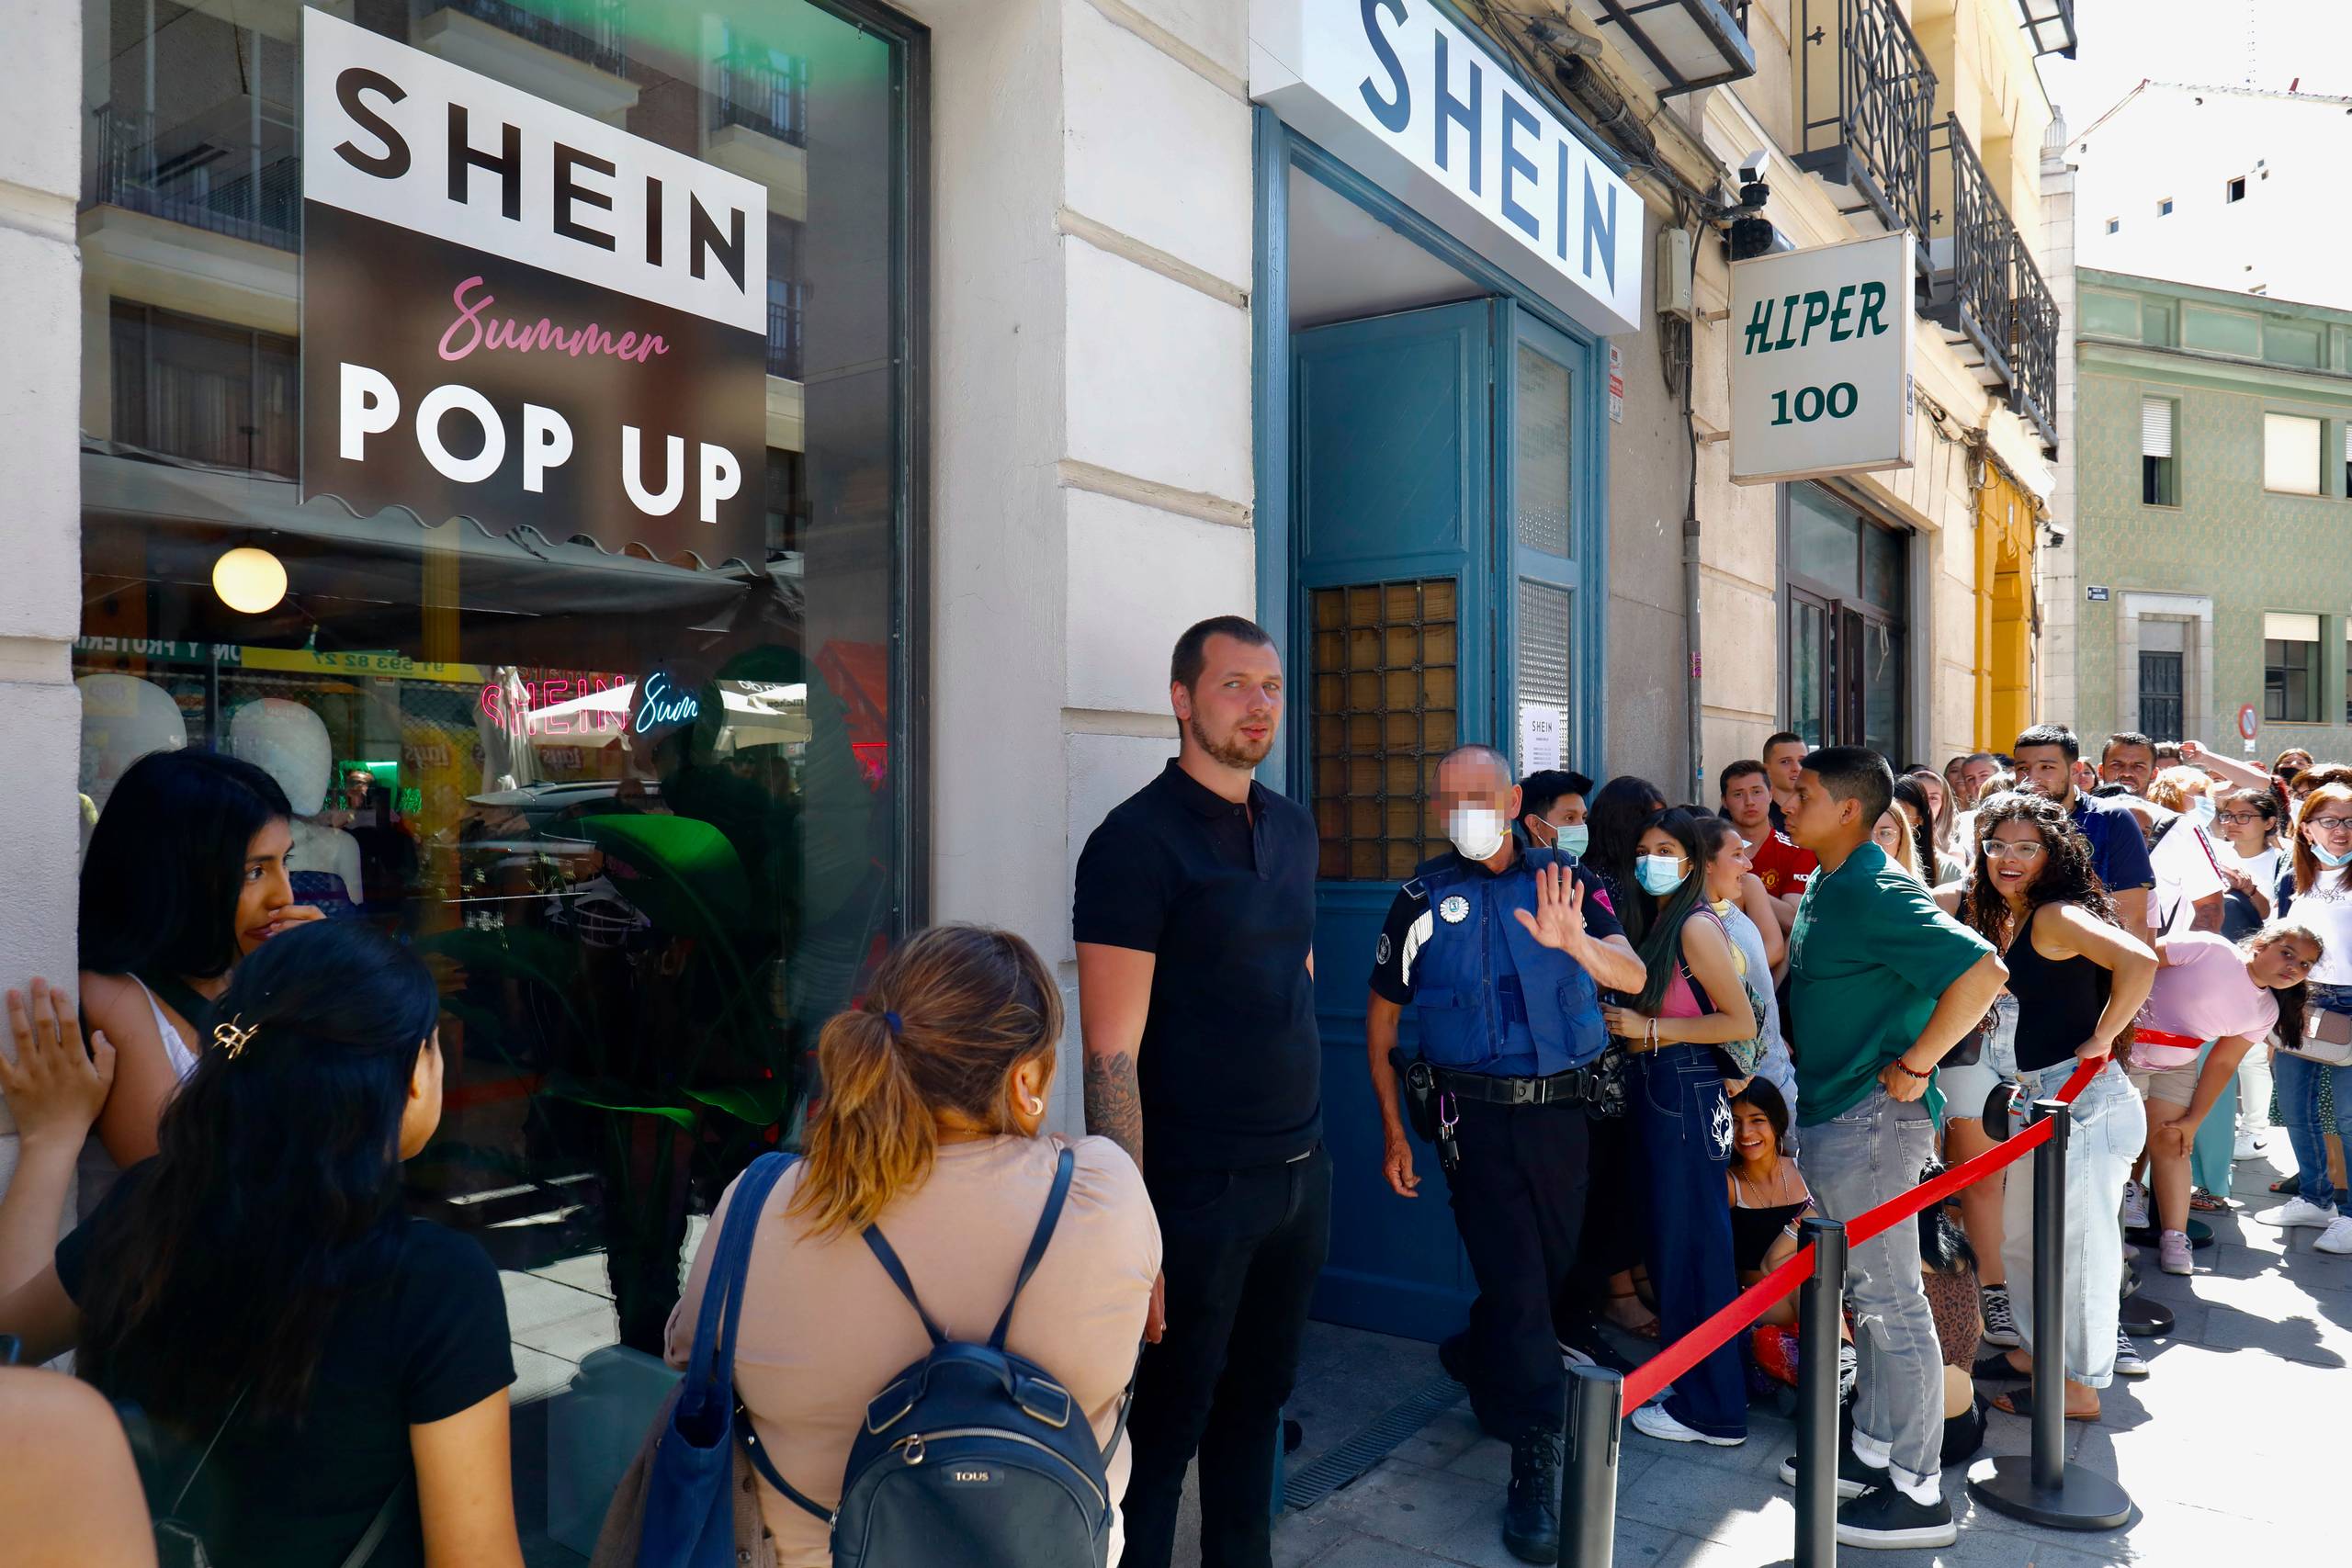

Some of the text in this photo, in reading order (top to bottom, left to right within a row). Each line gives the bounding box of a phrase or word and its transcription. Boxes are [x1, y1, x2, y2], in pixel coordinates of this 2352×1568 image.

[333, 67, 746, 296] SHEIN
[1359, 0, 1617, 299] SHEIN
[437, 276, 670, 363] Summer
[1745, 281, 1889, 355] HIPER
[1770, 382, 1859, 426] 100
[340, 362, 741, 524] POP UP
[481, 676, 626, 736] SHEIN
[1532, 720, 1553, 733] SHEIN
[955, 1472, 989, 1482] TOUS
